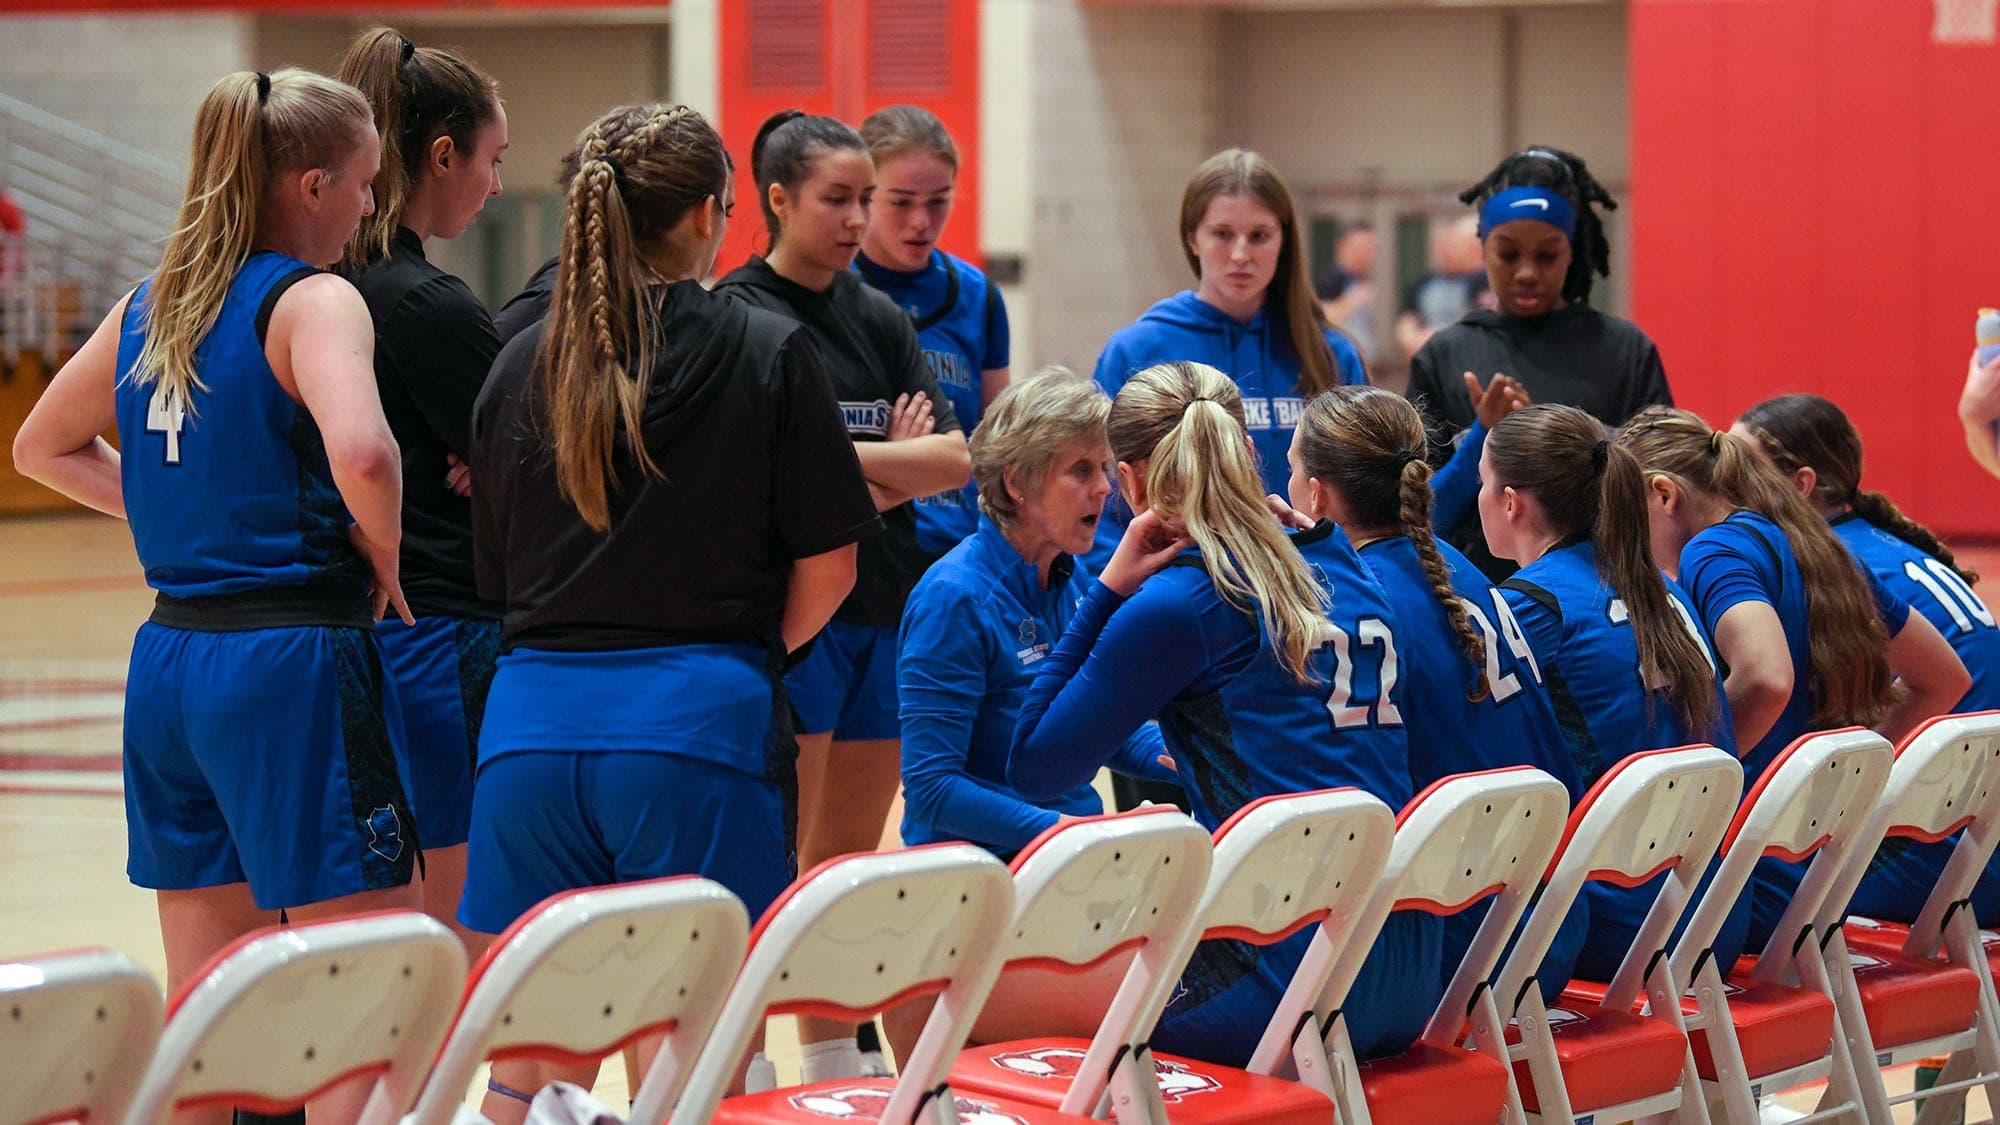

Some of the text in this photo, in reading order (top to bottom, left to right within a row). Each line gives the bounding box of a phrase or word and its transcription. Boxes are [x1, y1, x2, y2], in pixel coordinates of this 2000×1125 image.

[147, 386, 184, 462] 4
[841, 407, 874, 427] NIA
[1904, 558, 1995, 633] 10
[1308, 619, 1403, 728] 22
[1460, 588, 1542, 703] 24
